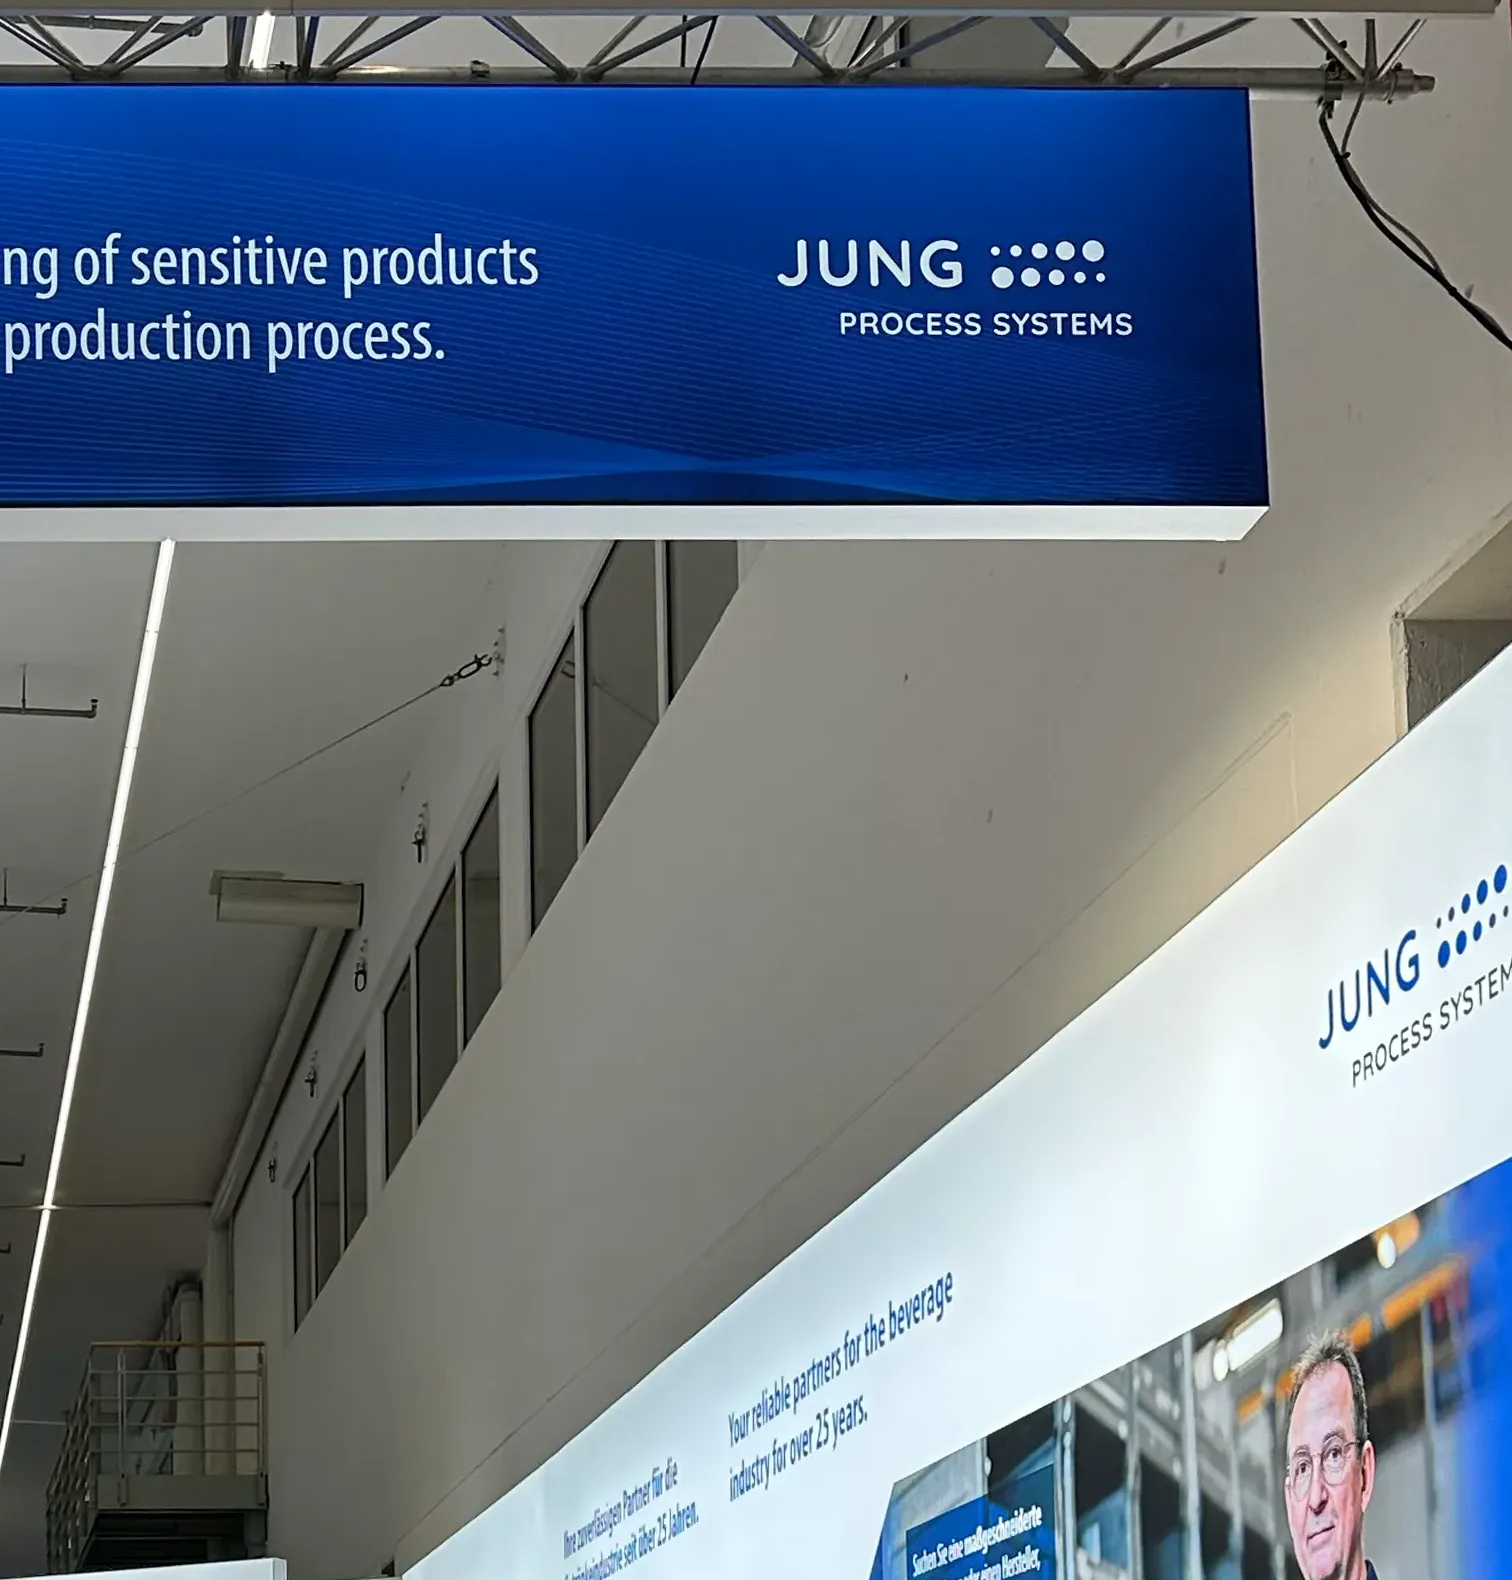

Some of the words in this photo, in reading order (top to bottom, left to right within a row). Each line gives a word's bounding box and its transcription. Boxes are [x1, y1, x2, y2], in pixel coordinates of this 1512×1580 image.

[74, 232, 122, 286] of
[131, 235, 328, 286] sensitive
[342, 232, 539, 299] products
[777, 239, 963, 288] JUNG
[4, 307, 251, 374] production
[267, 321, 445, 374] process.
[840, 312, 982, 336] PROCESS
[993, 312, 1133, 336] SYSTEMS
[1318, 929, 1420, 1049] JUNG
[1352, 1012, 1432, 1088] PROCESS
[728, 1410, 750, 1448] Your
[752, 1376, 790, 1433] reliable
[793, 1347, 841, 1415] partners
[843, 1329, 861, 1371] for
[864, 1313, 885, 1357] the
[888, 1271, 953, 1342] beverage
[730, 1454, 770, 1502] industry
[772, 1438, 788, 1476] for
[790, 1426, 814, 1465] over
[816, 1407, 829, 1450] 25
[832, 1394, 868, 1451] years.
